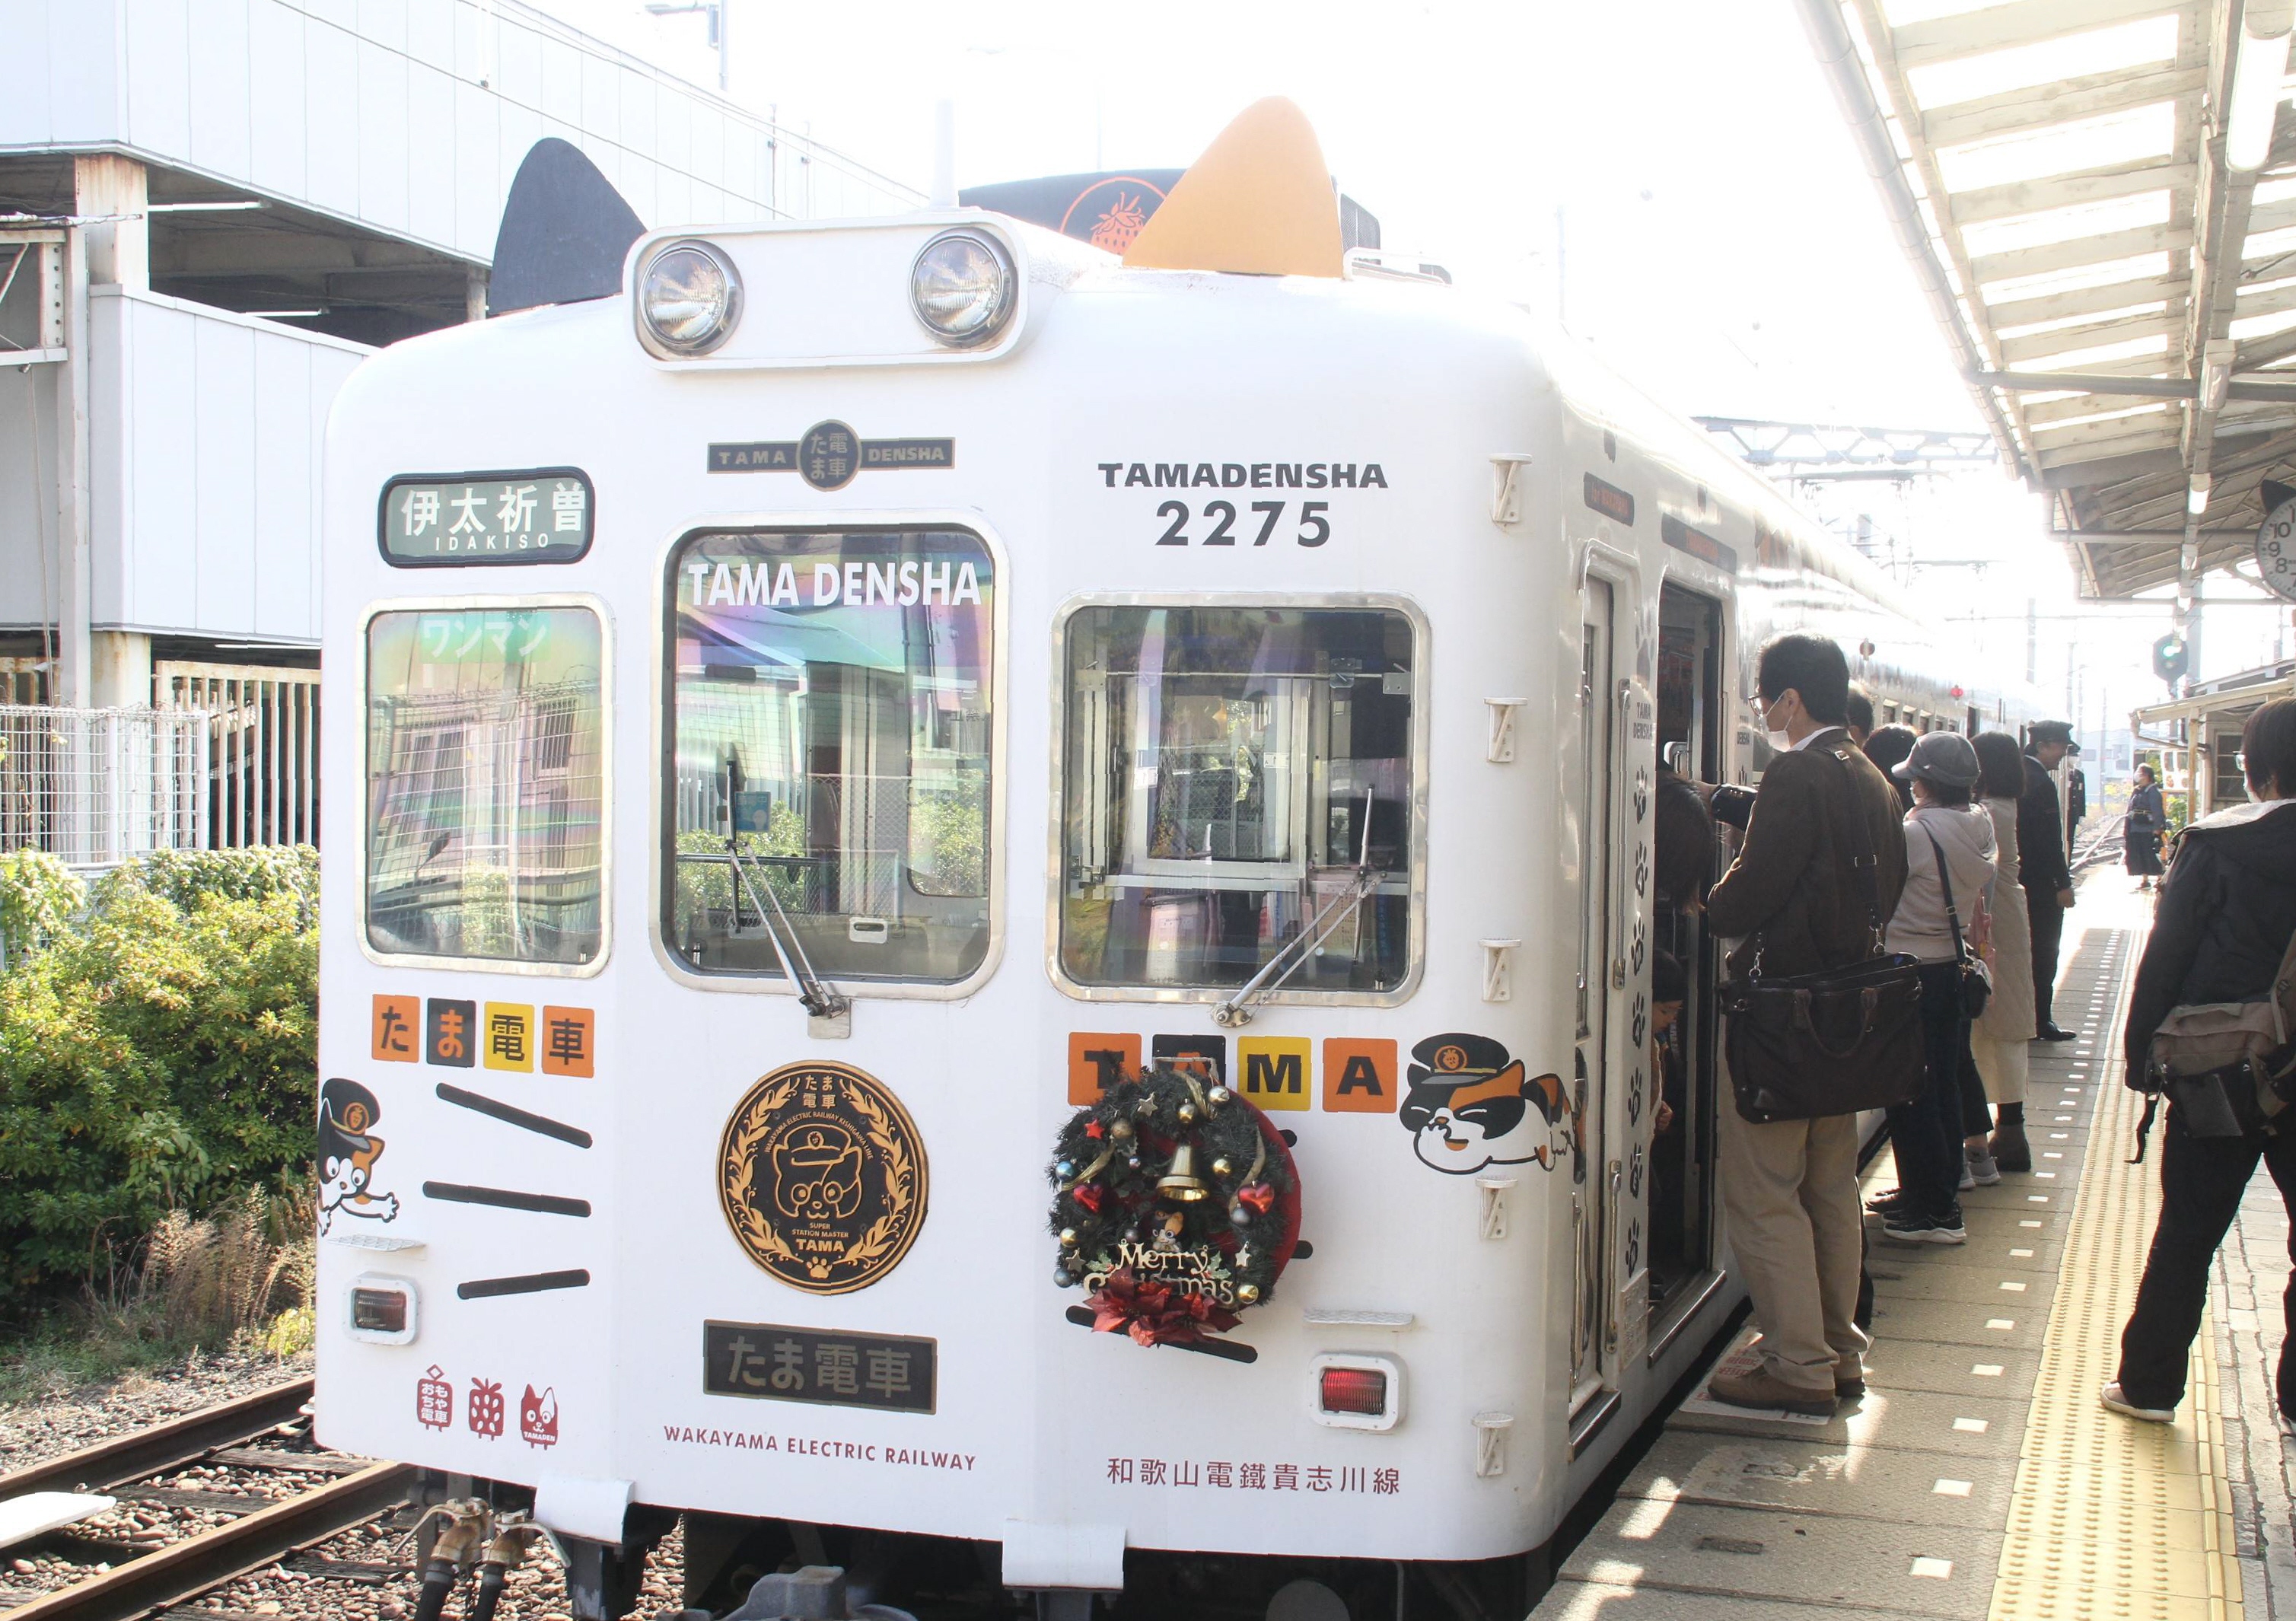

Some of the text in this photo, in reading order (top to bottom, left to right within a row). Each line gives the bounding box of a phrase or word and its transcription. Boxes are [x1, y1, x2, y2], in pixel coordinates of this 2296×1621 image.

[718, 450, 788, 466] TAMA
[867, 446, 945, 463] DENSHA
[1097, 462, 1389, 489] TAMADENSHA
[400, 482, 587, 537] 伊太祈曽
[1154, 499, 1331, 549] 2275
[2269, 521, 2291, 538] 10
[435, 533, 549, 552] IDAKISO
[2268, 541, 2282, 558] 9
[2275, 557, 2288, 574] 8
[687, 561, 982, 607] TAMA DENSHA
[422, 617, 547, 659] ワンマン
[381, 1004, 585, 1065] たま電車
[805, 1075, 833, 1091] たま
[803, 1093, 836, 1110] 電車
[764, 1111, 874, 1161] WAKAYAMA ELECTRIC RAILWAY KISHIGAWA LINE
[791, 1228, 849, 1238] STATION MASTER
[796, 1238, 845, 1253] TAMA
[1115, 1242, 1209, 1275] Merry
[728, 1334, 912, 1399] たま電車
[523, 1431, 556, 1442] TAMADEN
[664, 1425, 977, 1472] WAKAYAMA ELECTRIC RAILWAY
[1107, 1456, 1402, 1495] 和歌山電鐵貴志川線
